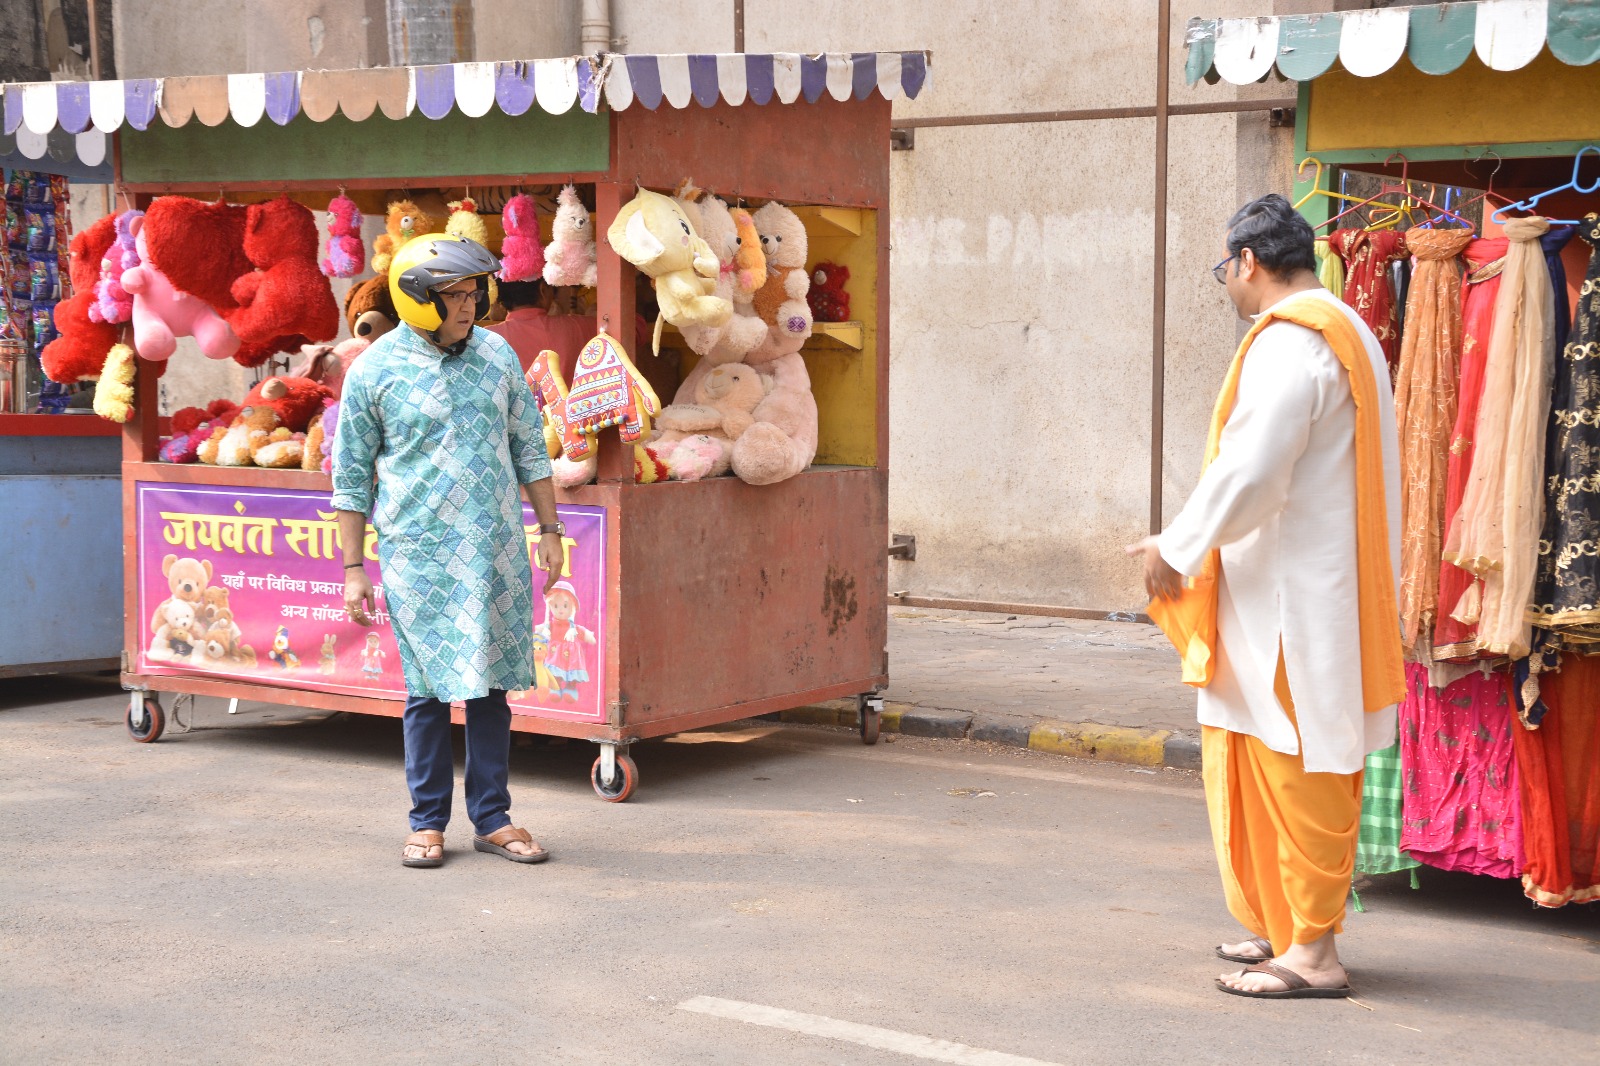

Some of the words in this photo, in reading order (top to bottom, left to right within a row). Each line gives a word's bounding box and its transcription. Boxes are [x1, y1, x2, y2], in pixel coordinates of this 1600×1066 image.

[159, 500, 279, 554] जयवंत
[221, 570, 245, 590] यहाँ
[247, 575, 265, 590] पर
[266, 573, 307, 593] विविध
[309, 580, 345, 596] प्रकार
[280, 604, 309, 619] अन्य
[311, 603, 346, 622] सॉफ्ट
